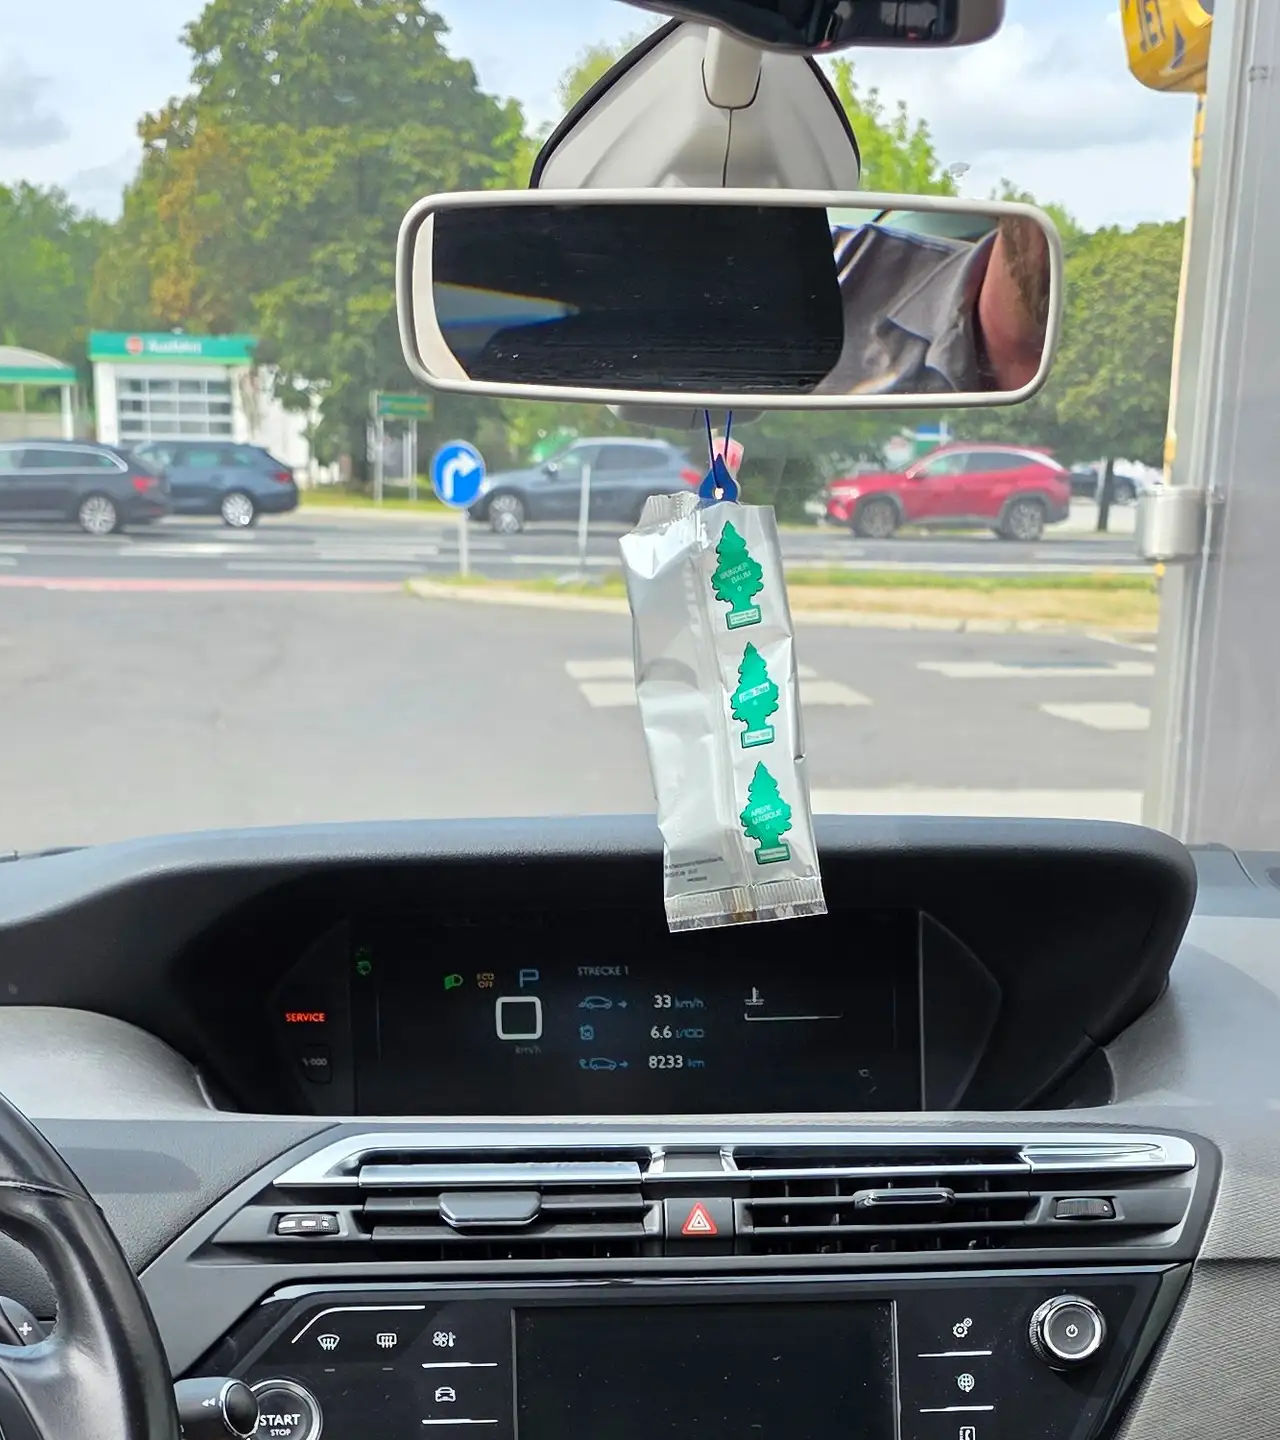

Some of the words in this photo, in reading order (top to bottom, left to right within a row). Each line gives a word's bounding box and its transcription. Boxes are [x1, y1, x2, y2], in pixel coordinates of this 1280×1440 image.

[578, 966, 621, 976] STRECKE
[653, 994, 671, 1009] 33
[674, 997, 705, 1009] km/h
[285, 1012, 325, 1022] SERVICE
[650, 1025, 672, 1039] 6.6
[648, 1054, 684, 1069] 8233
[686, 1058, 706, 1068] km
[260, 1413, 301, 1427] START
[270, 1428, 291, 1437] STOP
